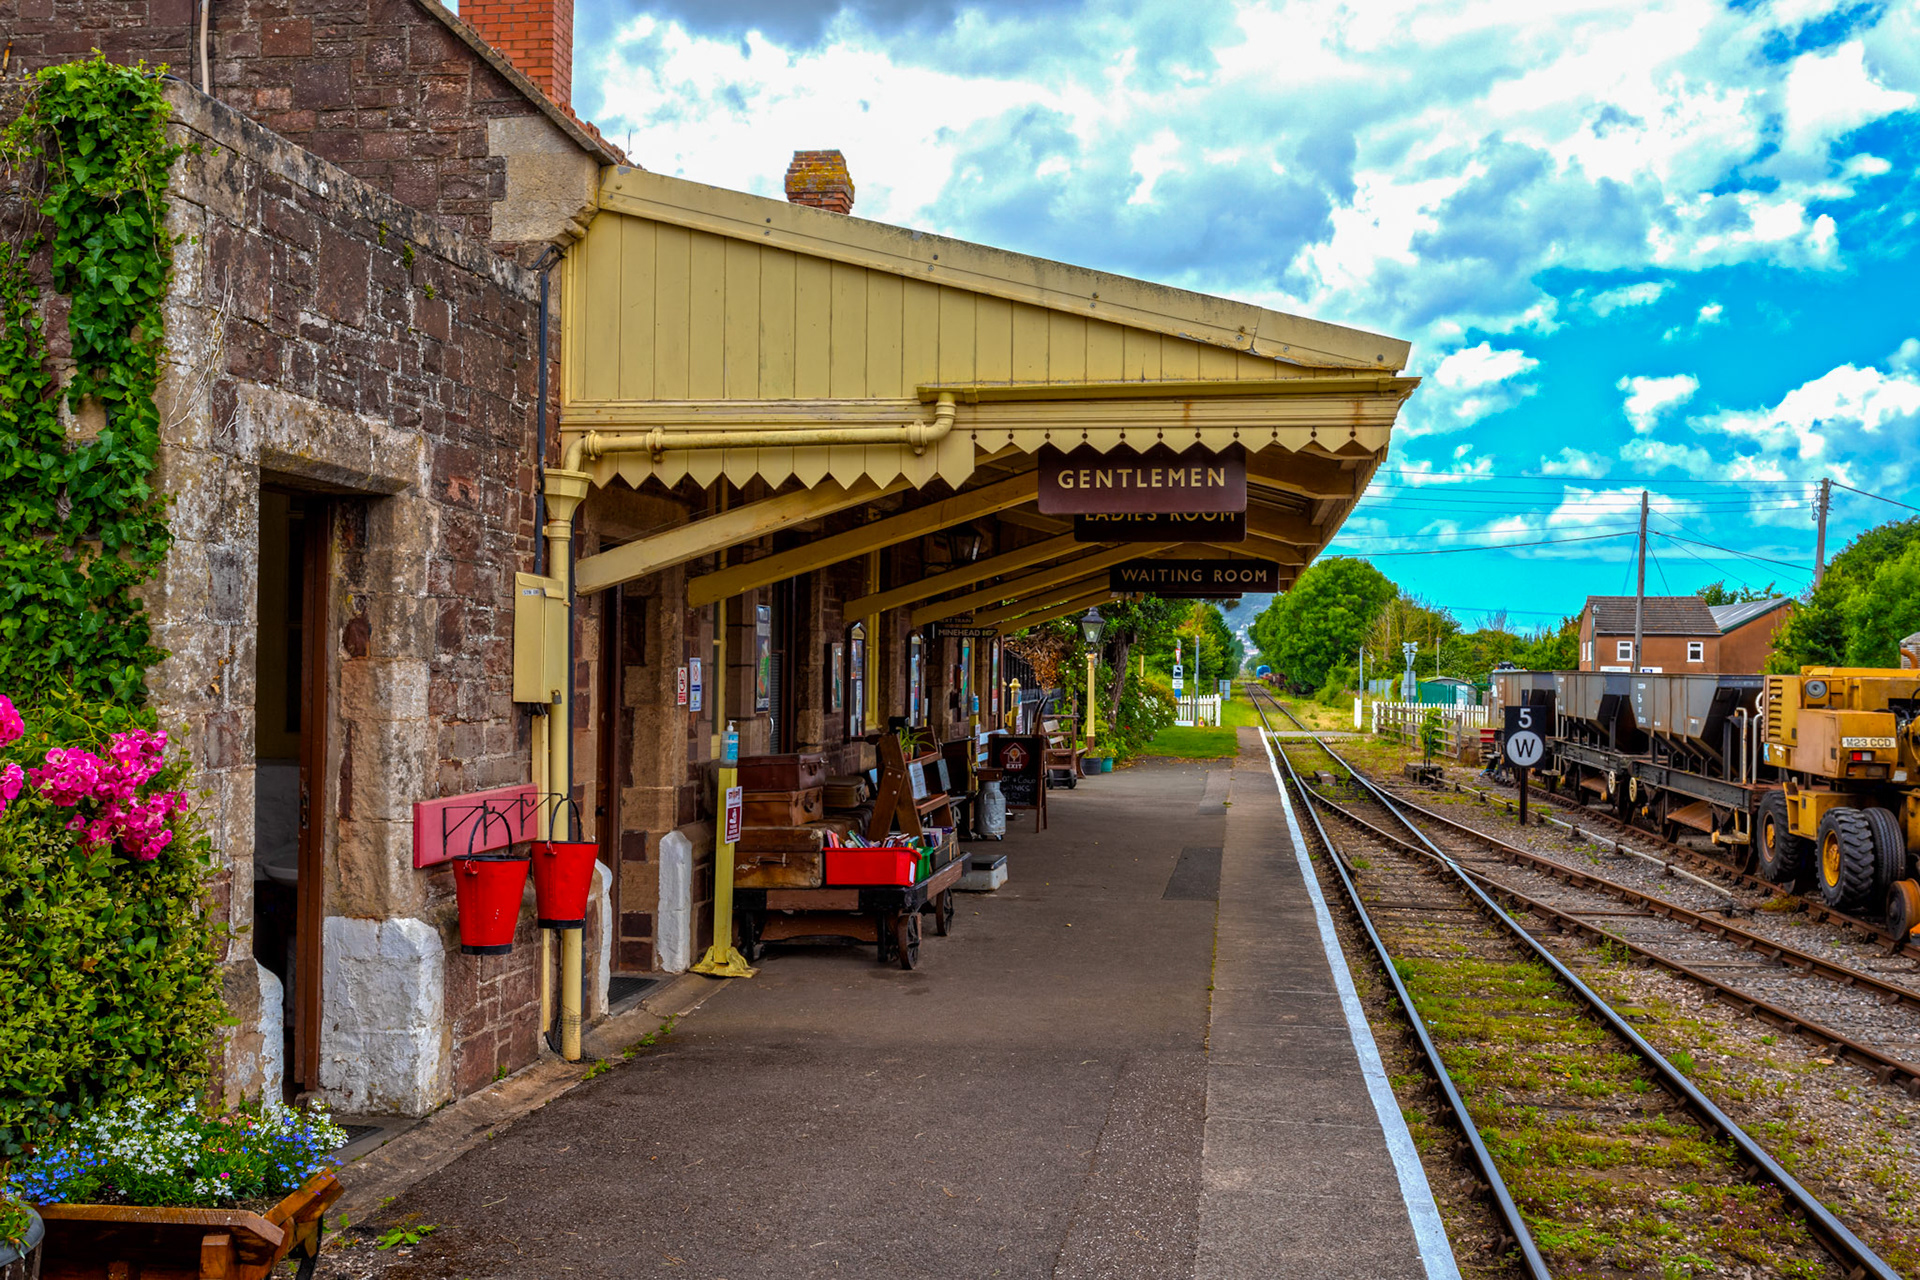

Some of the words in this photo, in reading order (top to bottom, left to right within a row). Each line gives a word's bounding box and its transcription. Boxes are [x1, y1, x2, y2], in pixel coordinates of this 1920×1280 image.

[1057, 467, 1226, 489] GENTLEMEN
[1121, 568, 1203, 582] WAITING
[1213, 569, 1268, 583] ROOM
[938, 629, 981, 637] MINEHEAD
[1518, 708, 1532, 729] 5
[1515, 739, 1535, 758] W
[1846, 738, 1868, 747] M23
[1870, 738, 1891, 747] CCD
